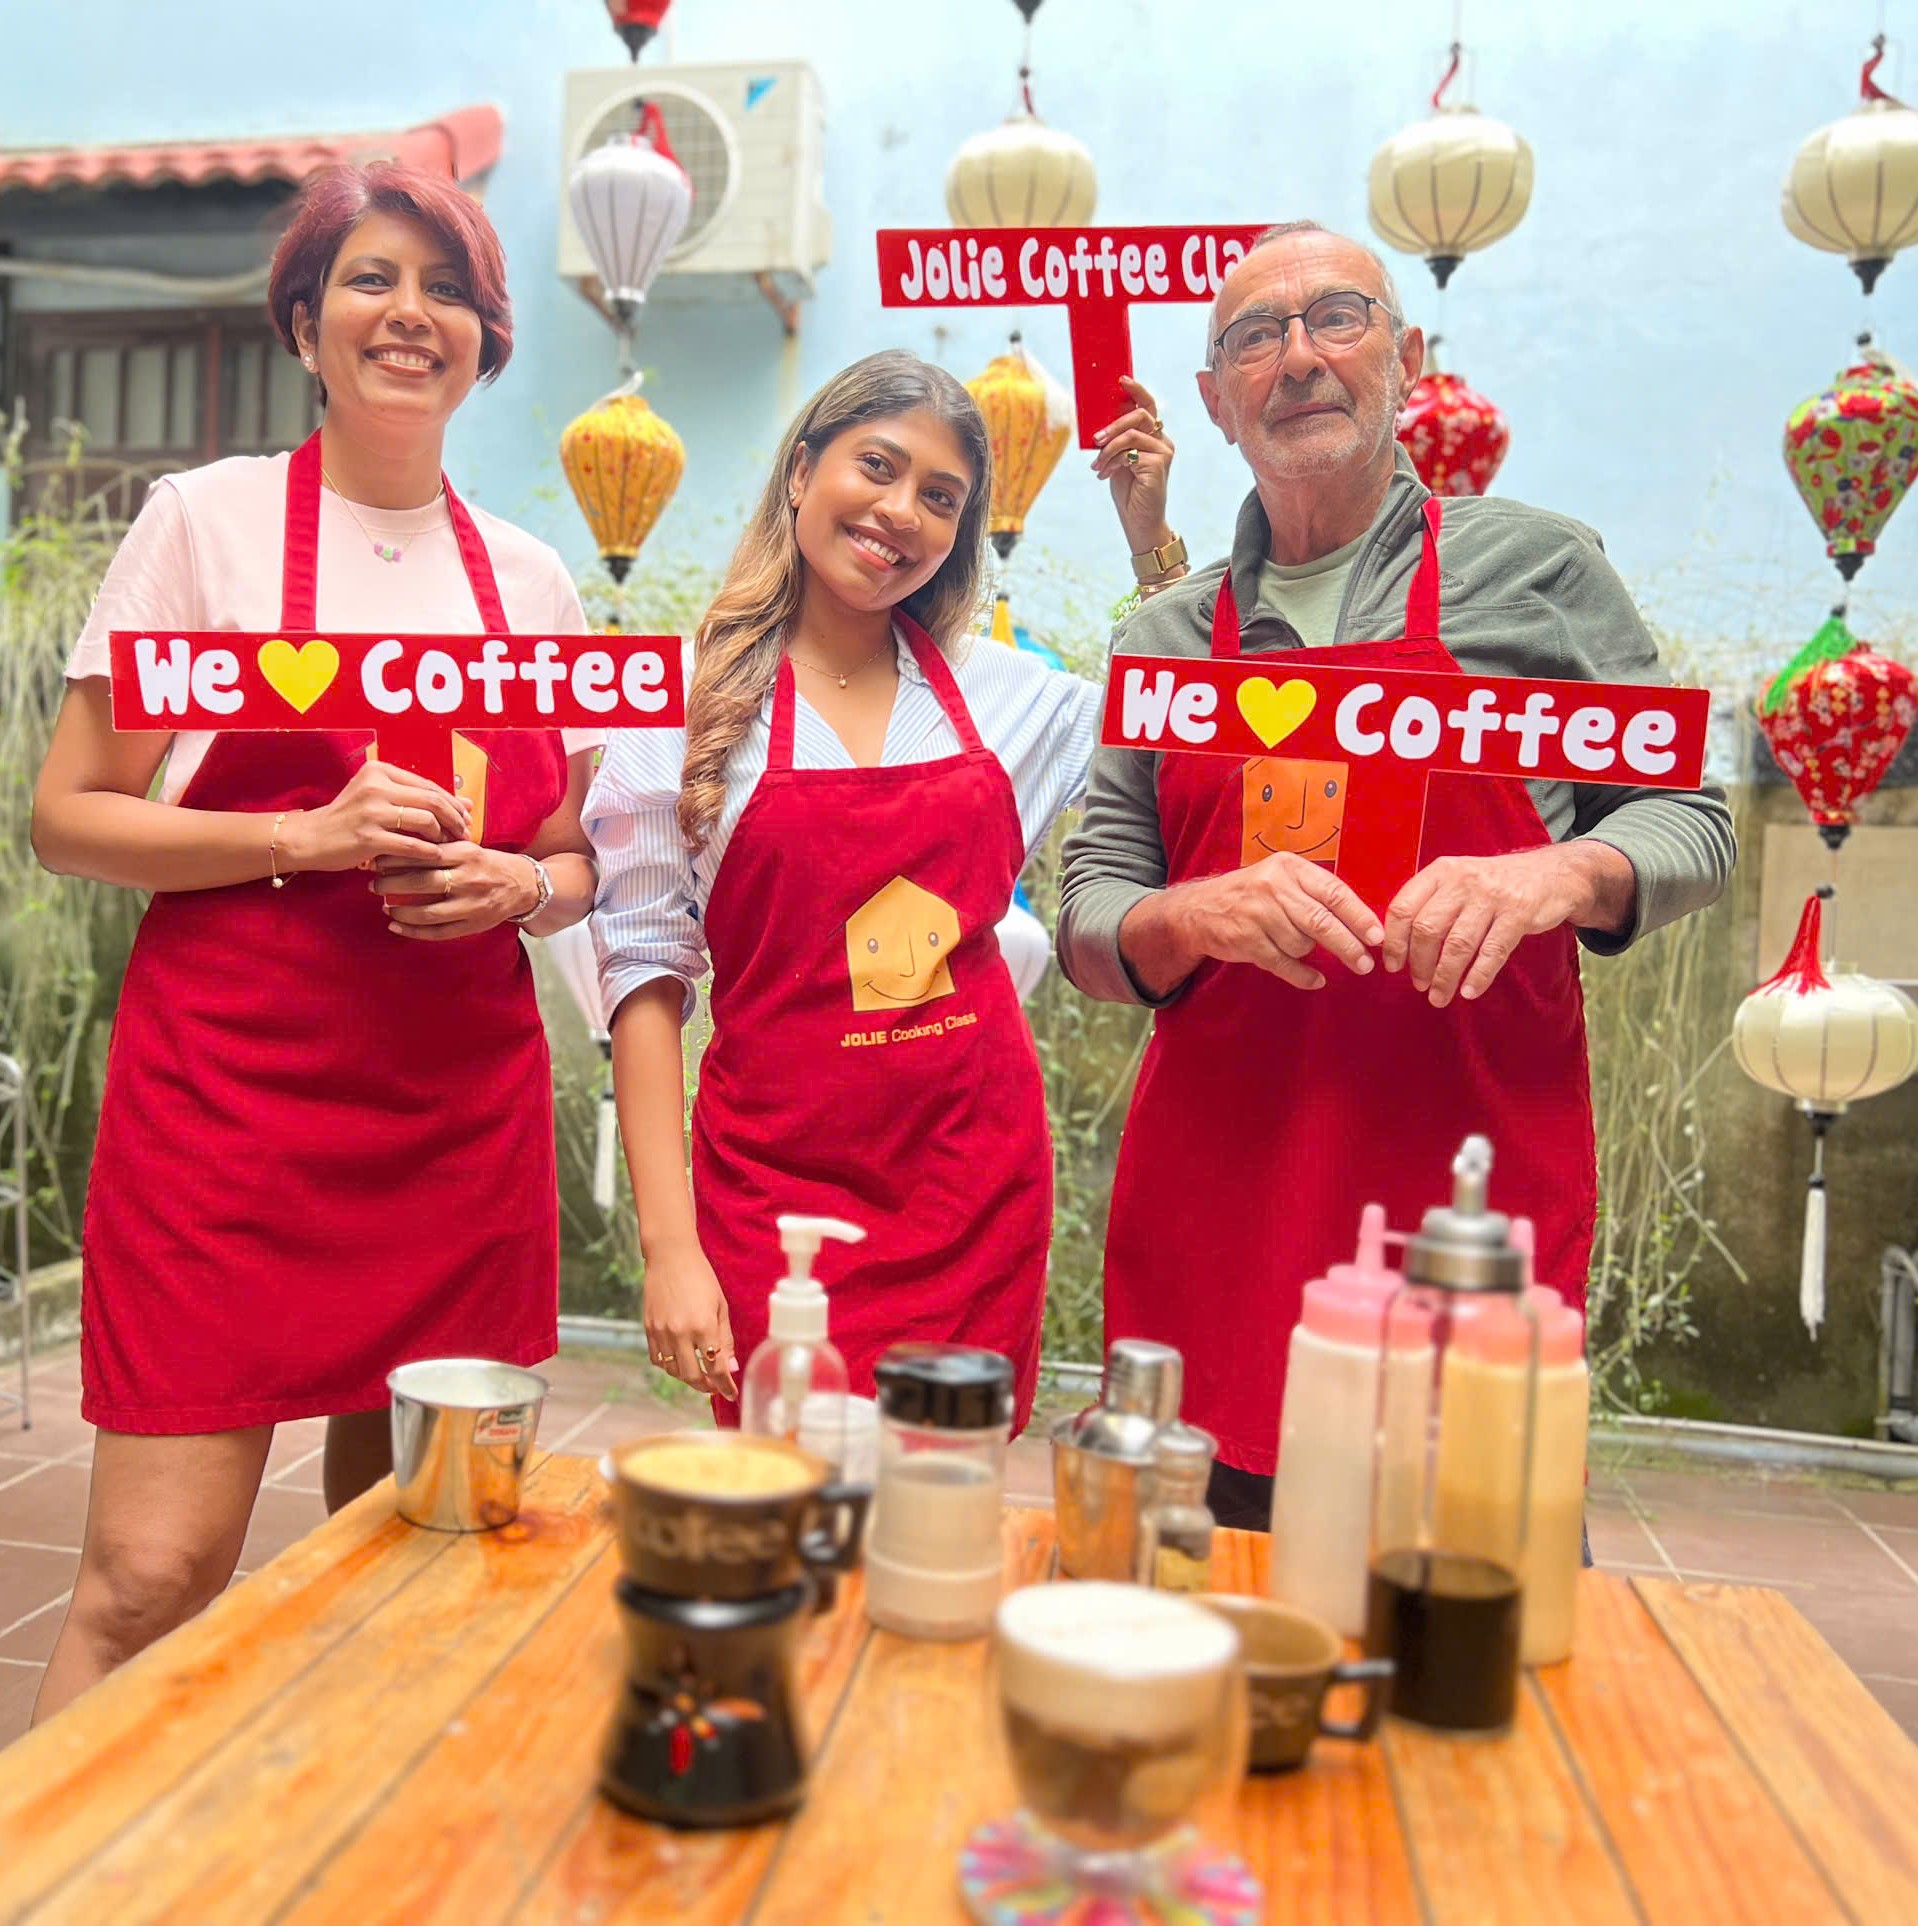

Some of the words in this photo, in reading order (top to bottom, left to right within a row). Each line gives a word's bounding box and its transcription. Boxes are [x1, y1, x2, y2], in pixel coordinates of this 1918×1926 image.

[901, 238, 1007, 300] Jolie
[1019, 237, 1170, 298] Coffee
[1181, 235, 1245, 295] Cla
[134, 639, 245, 715] We
[361, 640, 668, 714] Coffee
[1122, 668, 1218, 744] We
[1335, 683, 1676, 775] Coffee
[841, 1031, 887, 1047] JOLIE
[891, 1023, 943, 1042] Cooking
[944, 1013, 977, 1030] Class
